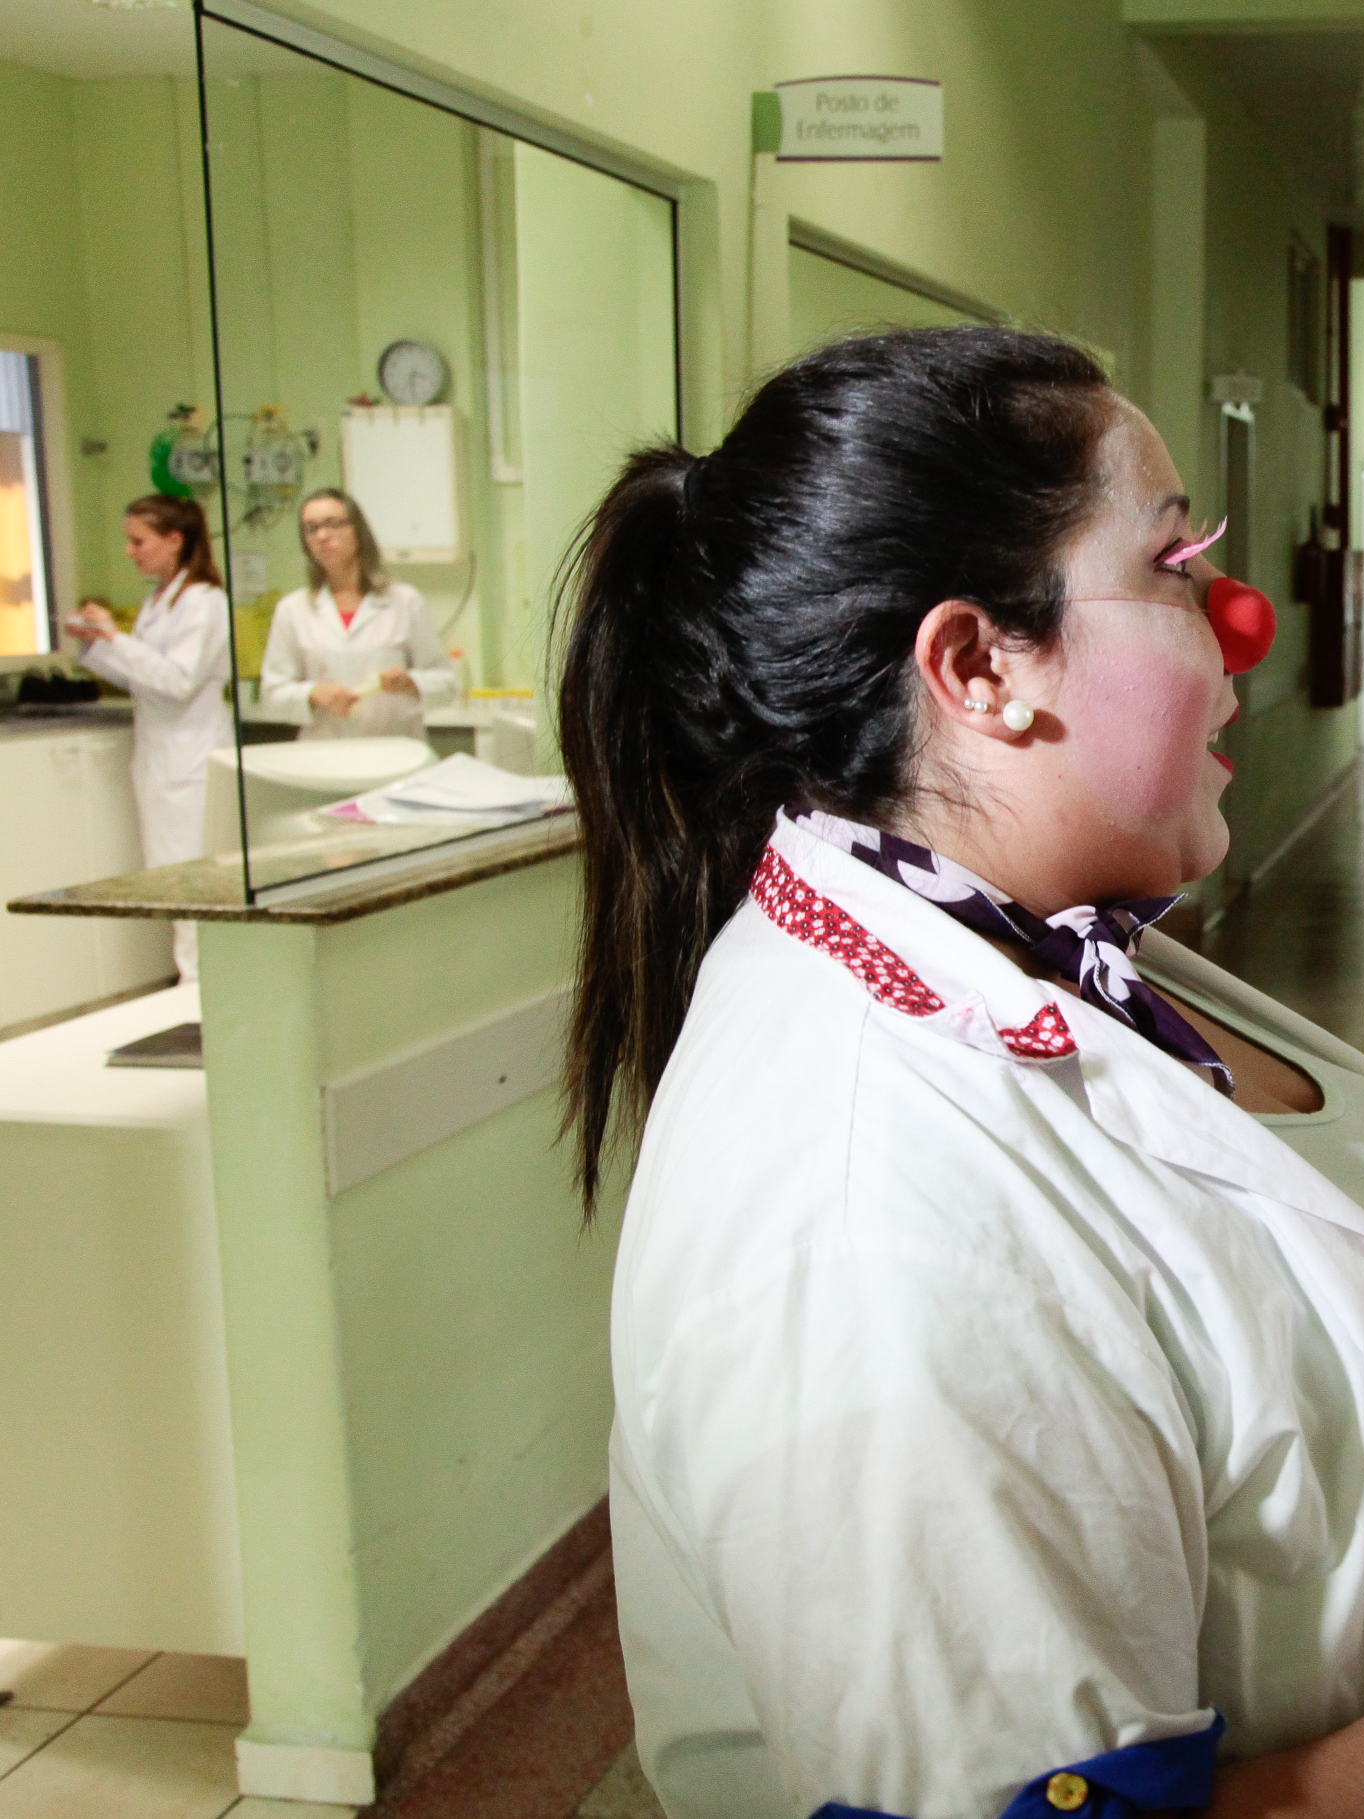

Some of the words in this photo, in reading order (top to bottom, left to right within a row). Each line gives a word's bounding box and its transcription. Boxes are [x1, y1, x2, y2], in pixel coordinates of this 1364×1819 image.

[815, 91, 869, 113] Posto
[874, 92, 899, 113] de
[796, 120, 921, 144] Enfermagem
